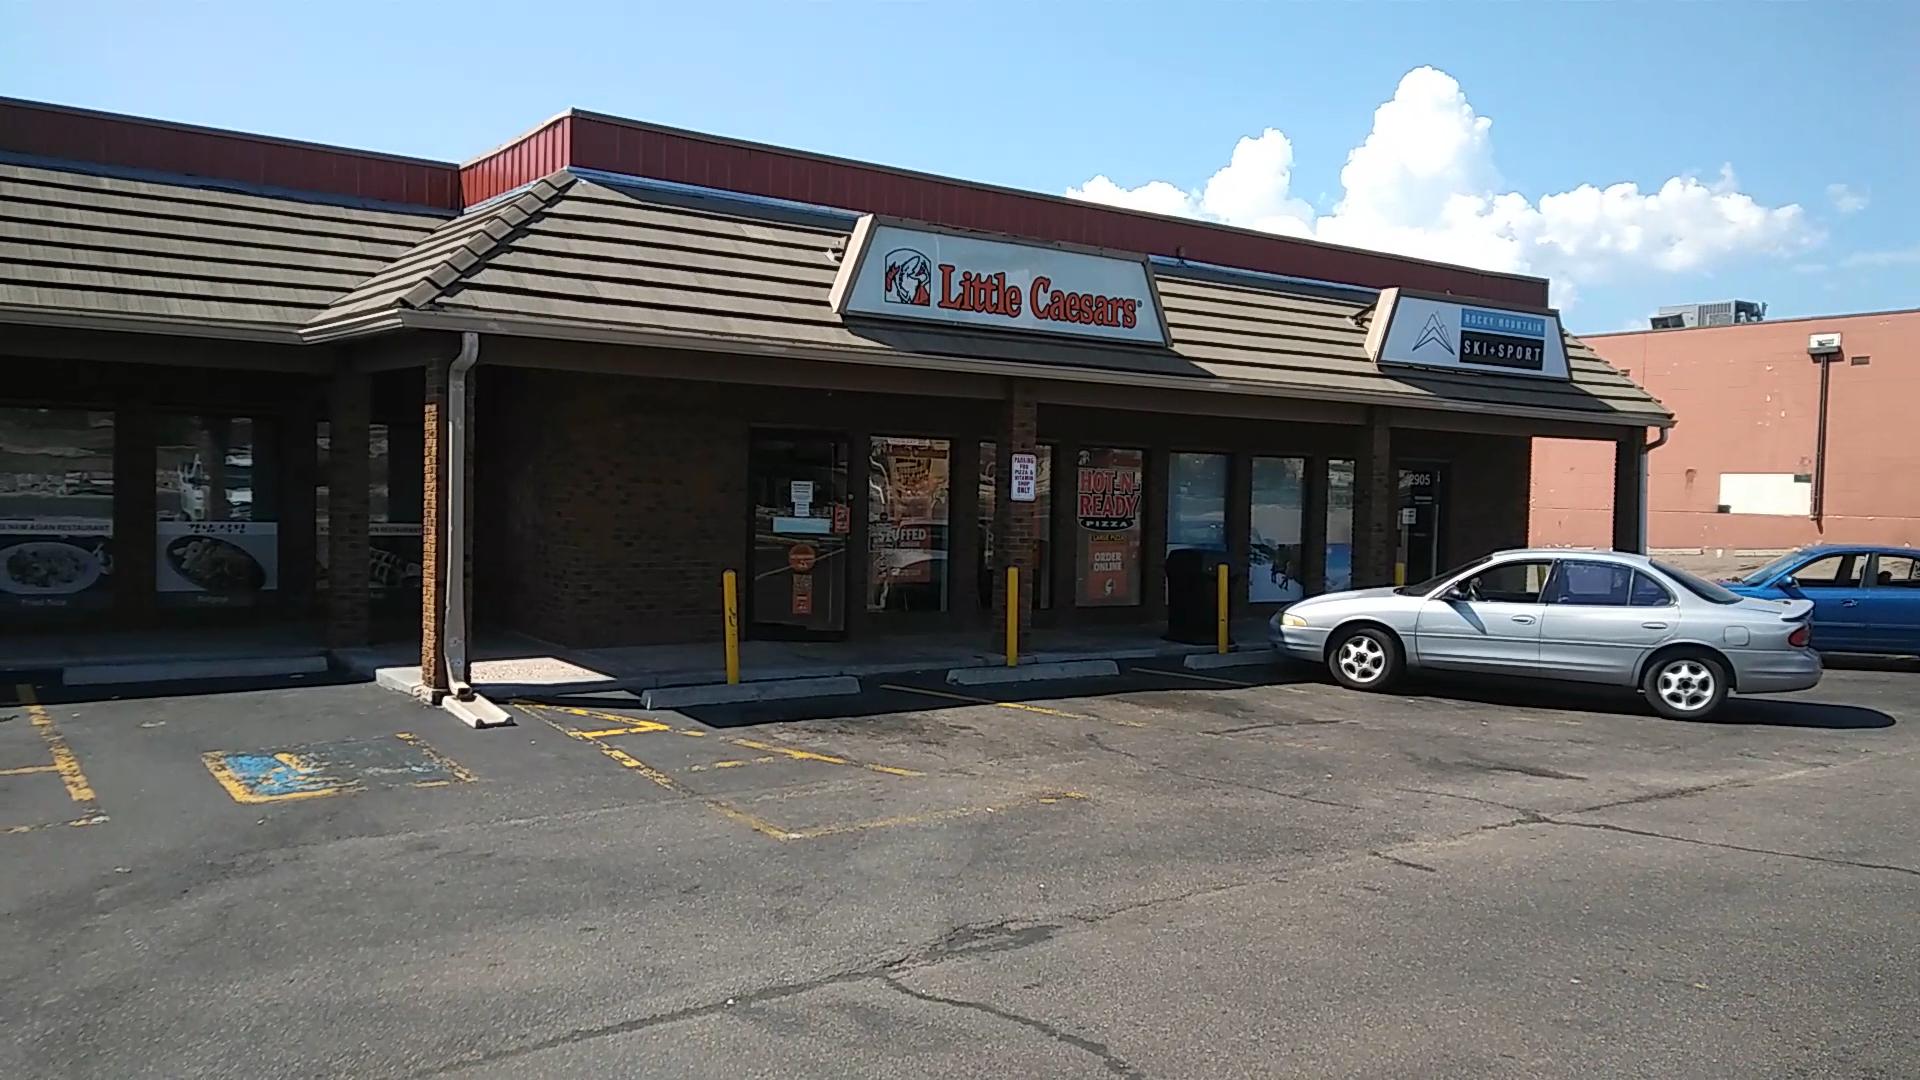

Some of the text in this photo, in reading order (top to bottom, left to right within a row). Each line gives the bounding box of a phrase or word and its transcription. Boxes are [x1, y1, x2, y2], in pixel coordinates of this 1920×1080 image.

[938, 264, 1138, 329] Little Caesars
[1464, 313, 1543, 334] ROCKY MOUNTAIN
[1409, 473, 1431, 486] 2905
[1079, 494, 1140, 518] READY
[1086, 520, 1128, 528] PIZZA
[1094, 551, 1121, 562] ORDER
[1093, 562, 1122, 571] ONLINE
